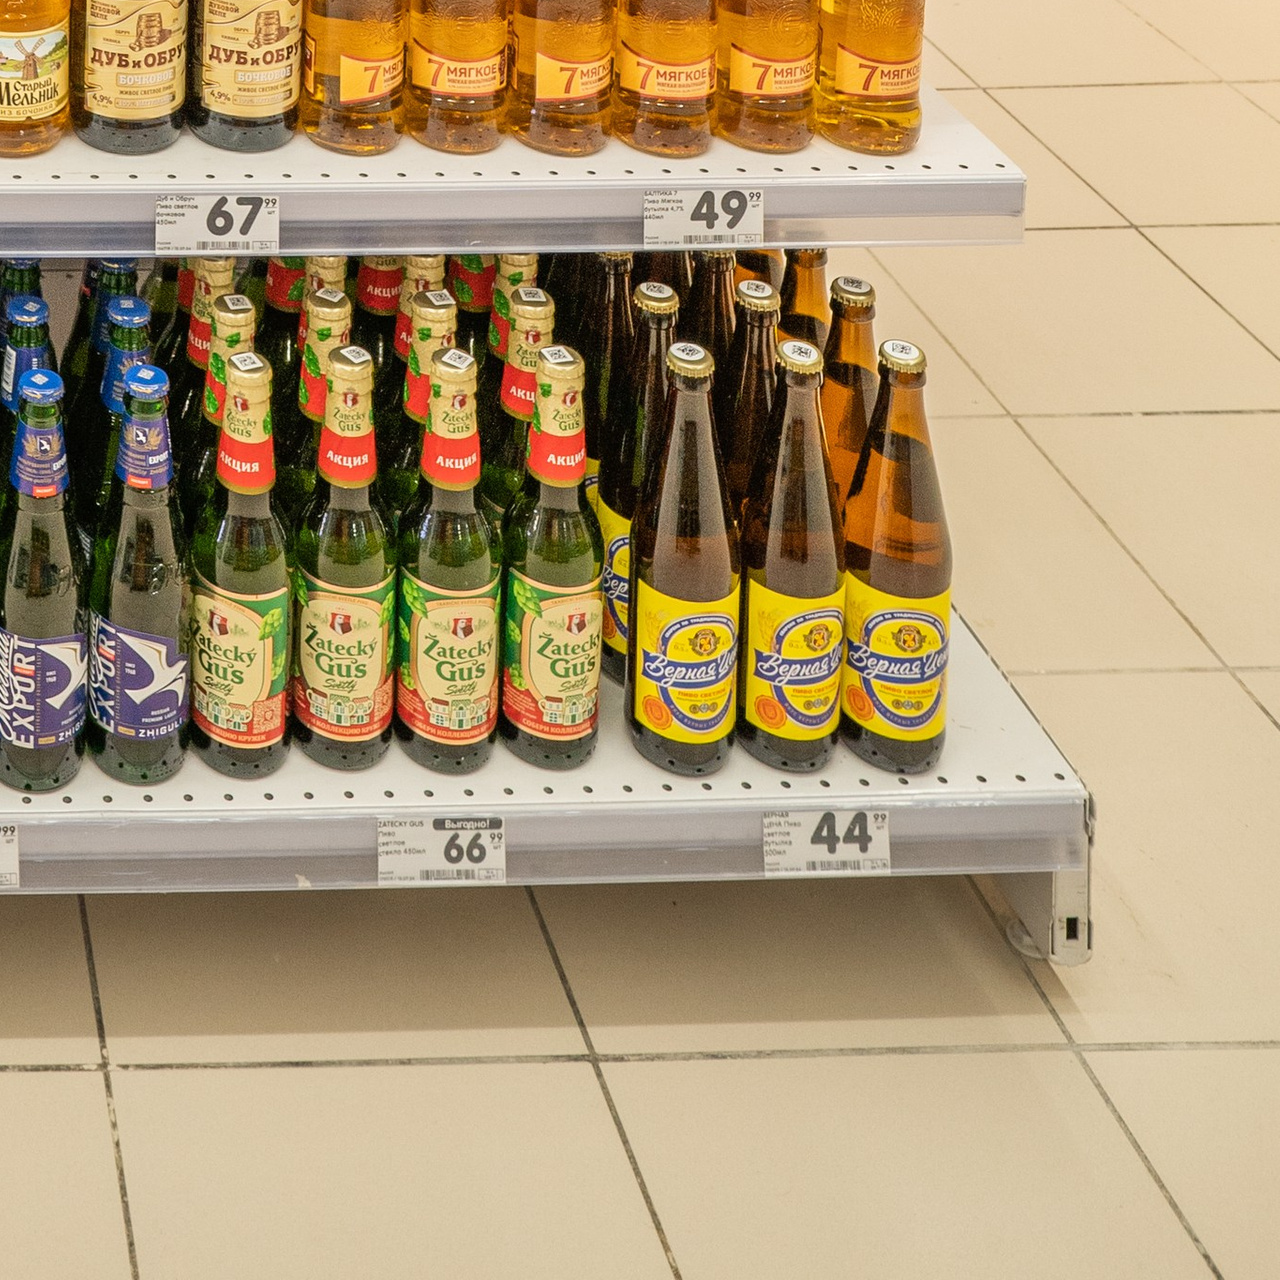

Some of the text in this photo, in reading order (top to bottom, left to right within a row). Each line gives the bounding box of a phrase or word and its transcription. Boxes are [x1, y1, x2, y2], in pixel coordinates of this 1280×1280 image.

[427, 57, 497, 87] 7 МЯГКОЕ
[206, 196, 277, 236] 67 99
[690, 190, 761, 230] 49 99
[327, 450, 368, 466] АКЦИЯ
[304, 622, 377, 657] Žatecký
[423, 632, 493, 658] Žatecký
[314, 652, 366, 680] Gus
[436, 660, 486, 682] Gus
[645, 653, 718, 685] Верная
[139, 718, 183, 738] ZHIGULI
[2, 826, 15, 836] 99
[378, 820, 407, 828] ZATECKY
[445, 818, 489, 830] Выгодно!
[811, 812, 886, 853] 44 99
[444, 833, 503, 864] 66 99
